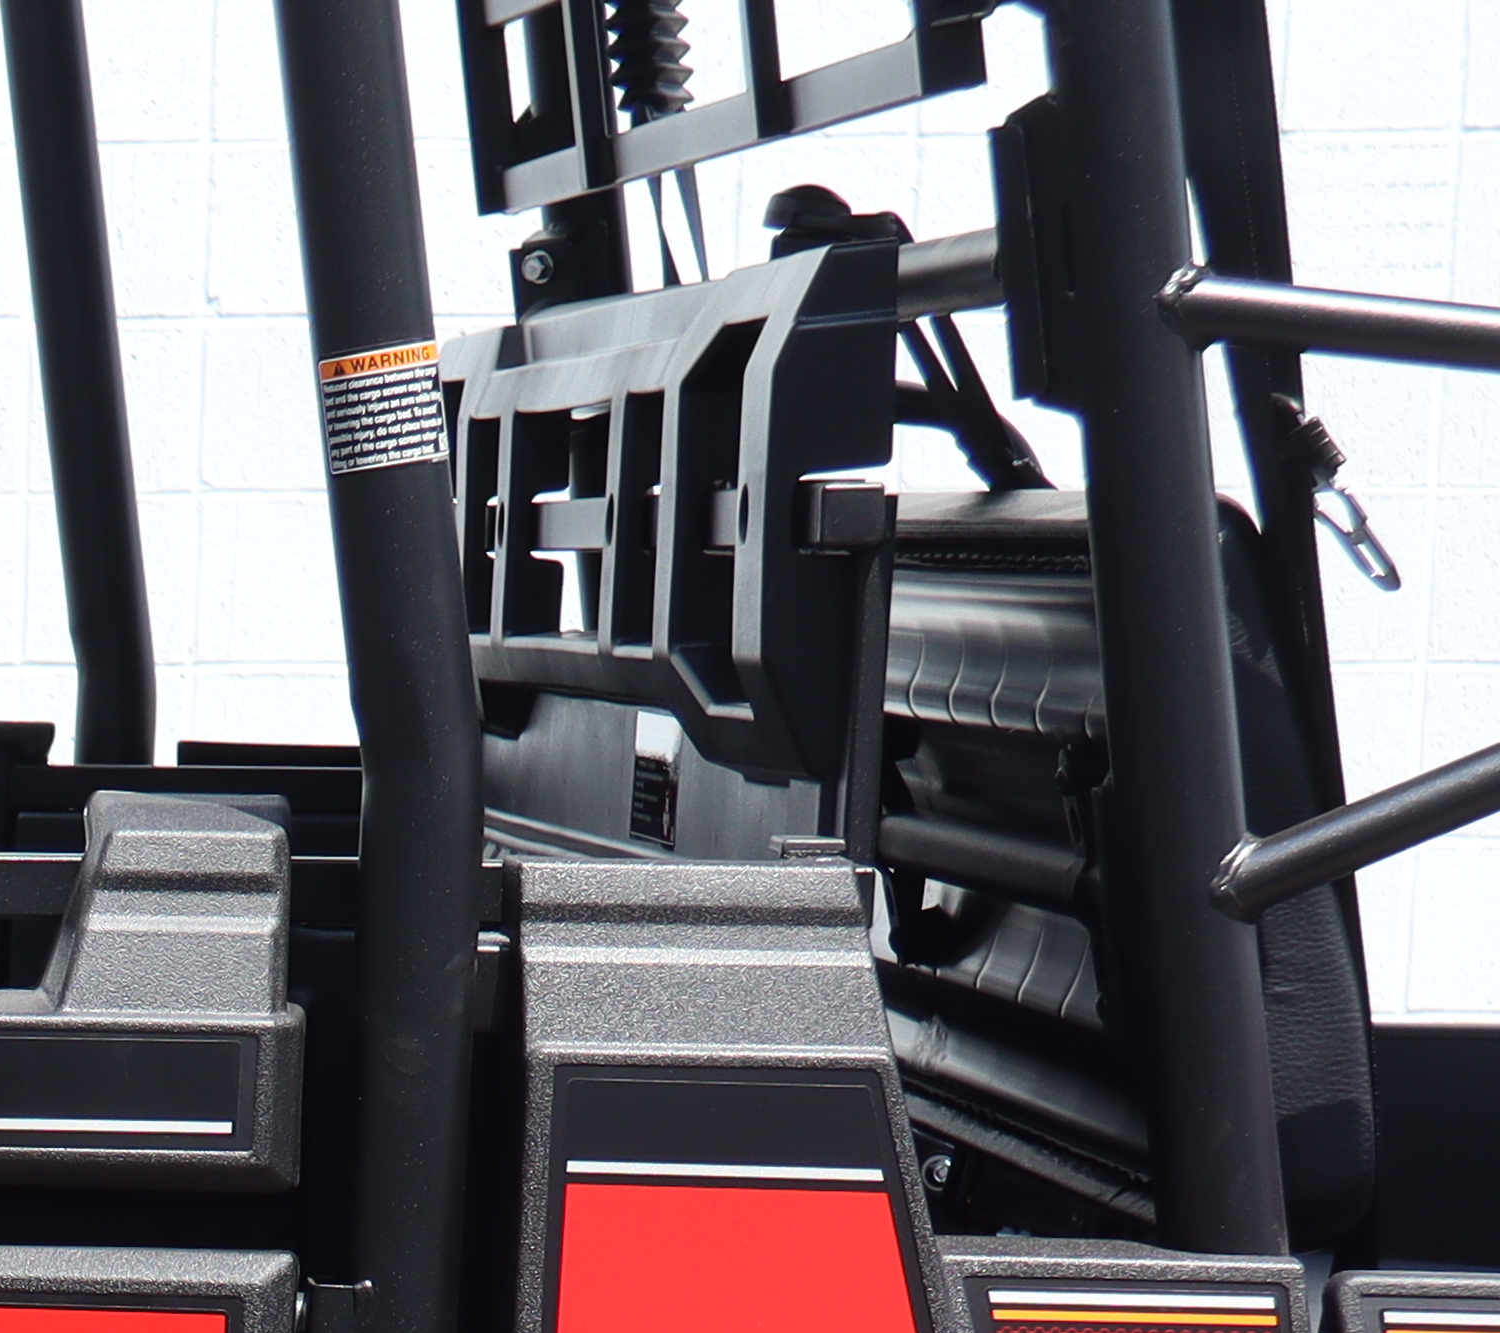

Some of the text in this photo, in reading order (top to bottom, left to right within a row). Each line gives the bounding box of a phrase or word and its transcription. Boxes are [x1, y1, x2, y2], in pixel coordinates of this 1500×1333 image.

[350, 347, 430, 372] WARNING
[347, 374, 383, 389] clearance
[383, 369, 414, 383] between
[346, 392, 358, 402] the
[359, 389, 381, 402] cargo
[382, 384, 407, 396] screen
[366, 399, 389, 413] injure
[360, 415, 374, 426] the
[374, 413, 396, 426] cargo
[376, 426, 387, 436] do
[387, 423, 401, 434] not
[401, 419, 420, 434] place
[353, 443, 361, 453] of
[362, 441, 374, 451] the
[375, 438, 397, 451] cargo
[398, 434, 421, 445] screen
[355, 451, 387, 467] lowering
[388, 449, 400, 459] the
[401, 446, 422, 459] cargo
